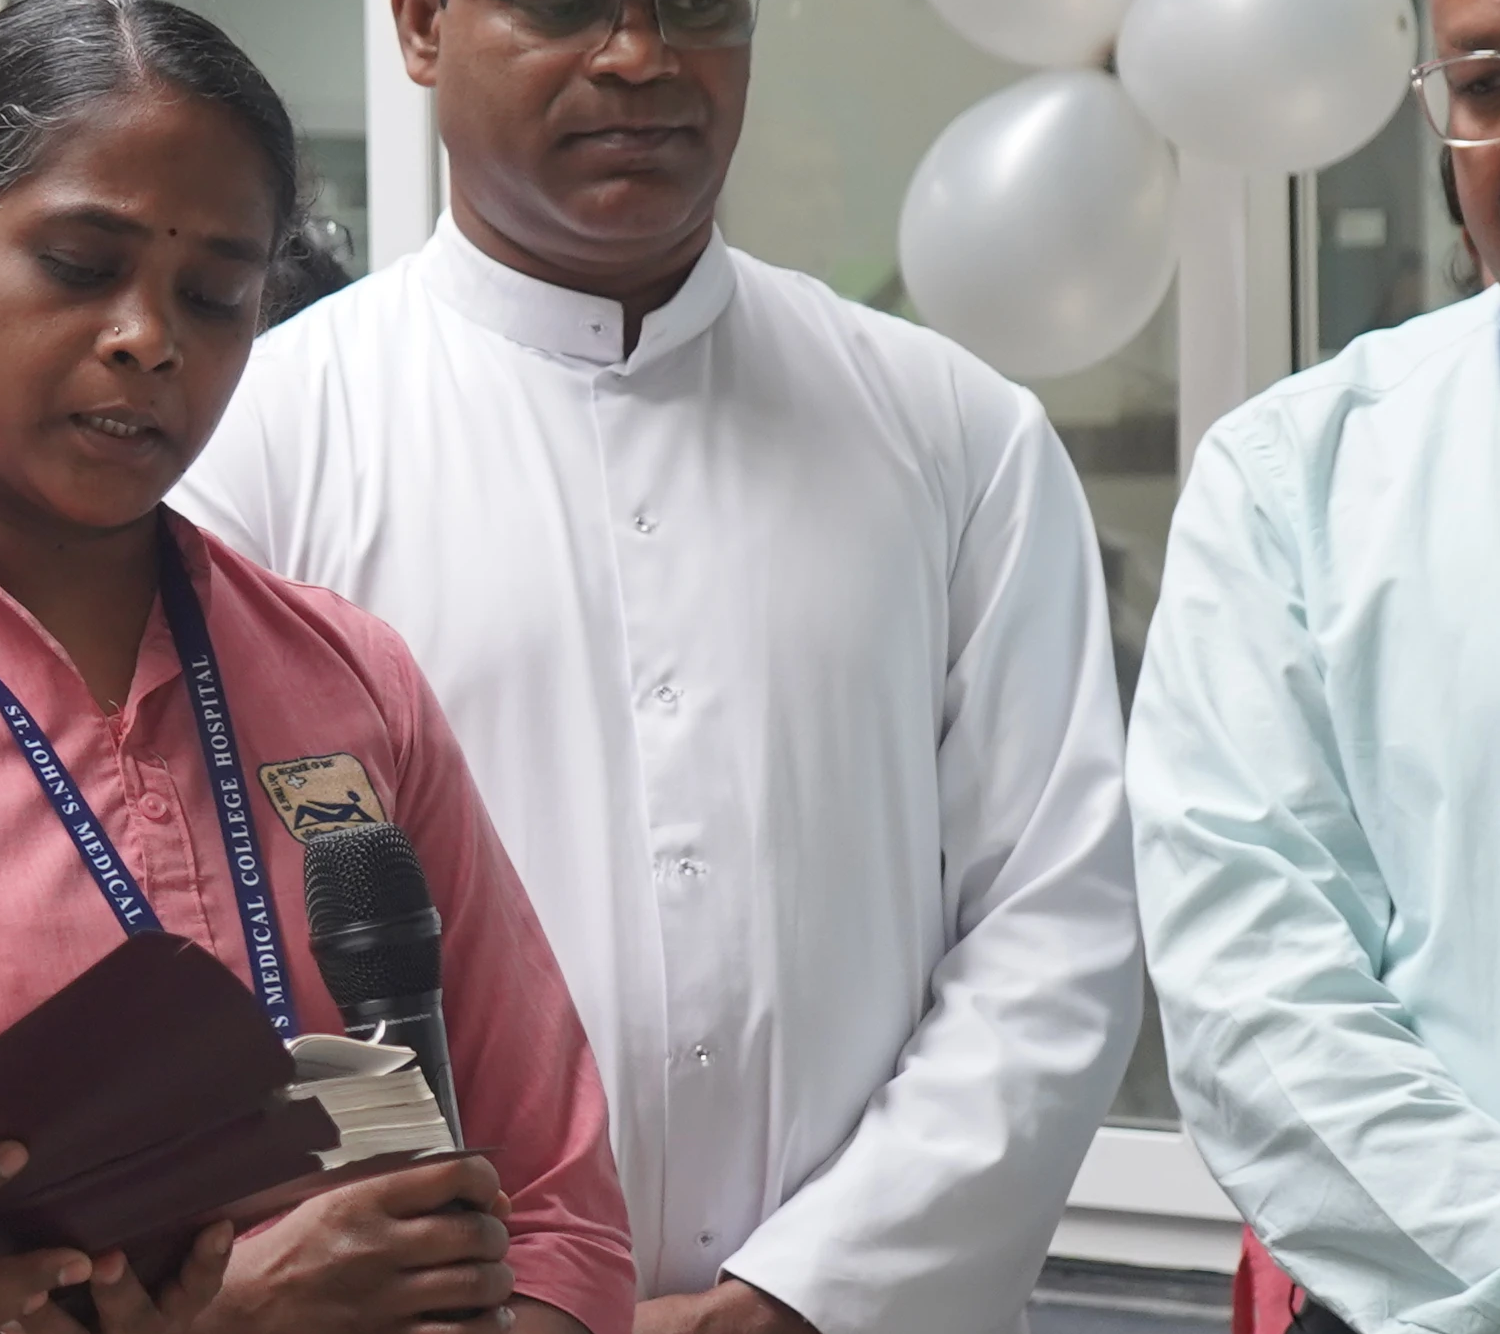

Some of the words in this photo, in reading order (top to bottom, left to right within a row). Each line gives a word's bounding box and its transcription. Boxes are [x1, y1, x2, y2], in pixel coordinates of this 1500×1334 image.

[192, 654, 233, 767] HOSPITAL
[4, 705, 32, 735] ST.
[24, 738, 80, 816] JOHN'S
[73, 820, 143, 925] MEDICAL
[220, 777, 260, 886] COLLEGE
[247, 895, 285, 1006] MEDICAL
